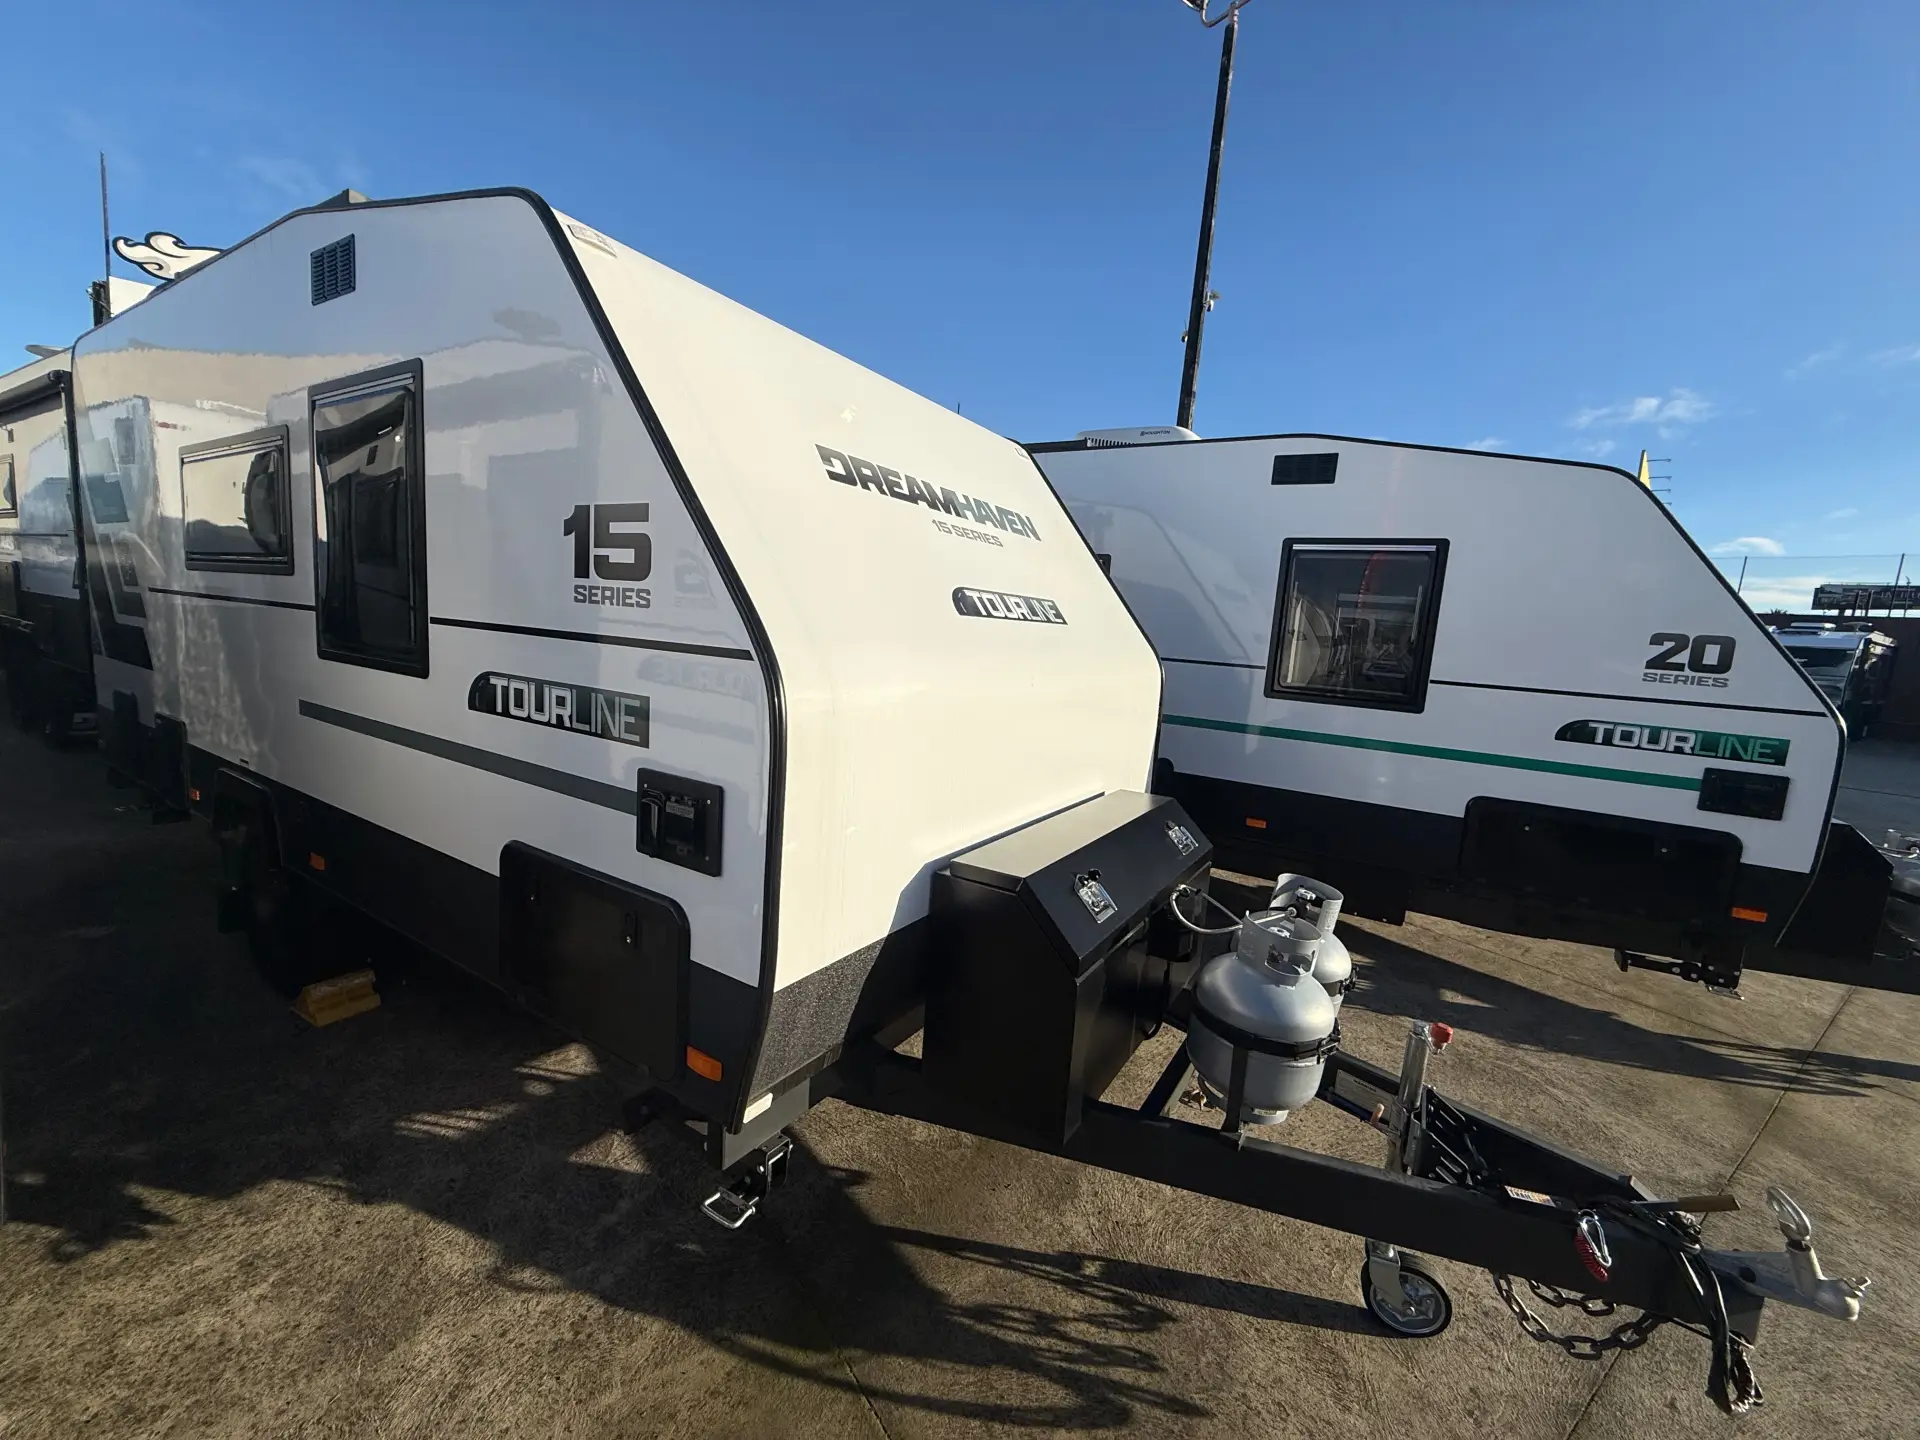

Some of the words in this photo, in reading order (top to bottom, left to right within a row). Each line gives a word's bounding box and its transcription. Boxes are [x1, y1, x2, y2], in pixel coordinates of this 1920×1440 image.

[815, 443, 1042, 542] DREAMHAVEN
[563, 502, 651, 581] 15
[932, 518, 953, 535] 15
[951, 524, 1004, 548] SERIES
[573, 584, 651, 609] SERIES
[963, 589, 1064, 623] TOURLINE
[1644, 632, 1737, 675] 20
[1641, 672, 1730, 688] SERIES
[489, 675, 641, 743] TOURLINE
[1588, 721, 1779, 763] TOURLINE
